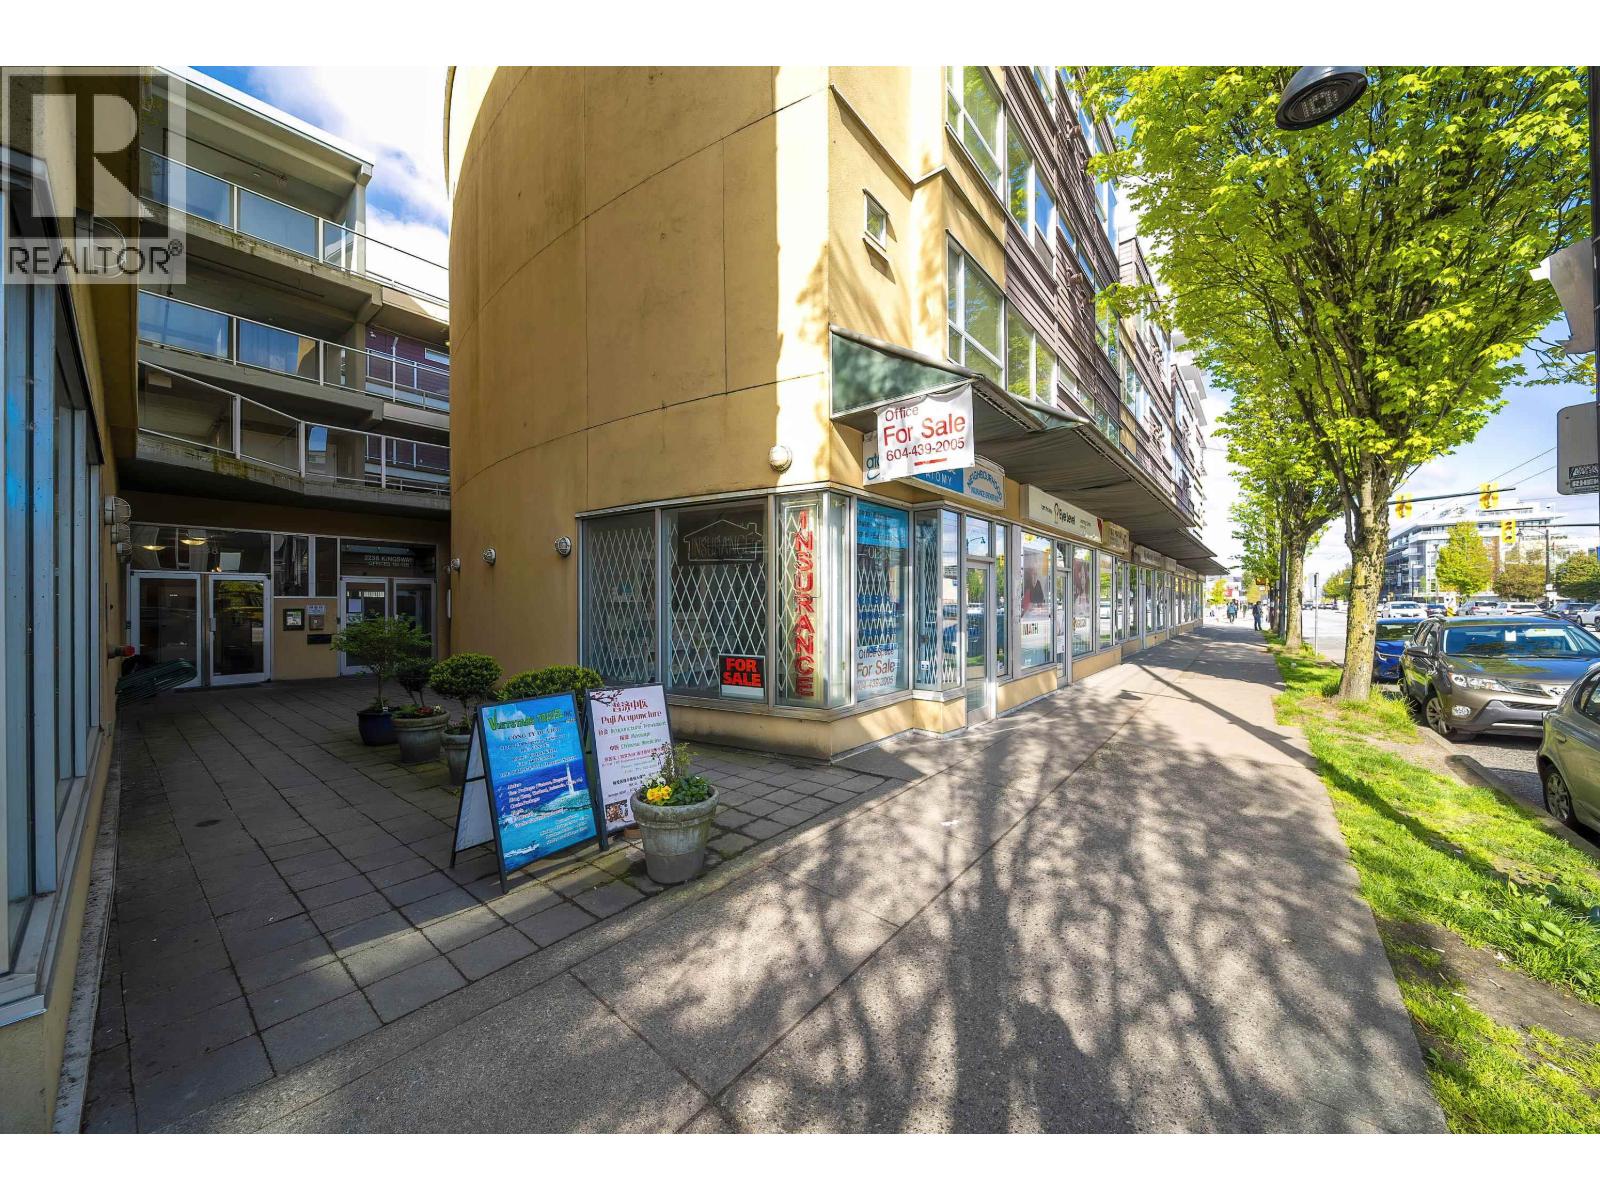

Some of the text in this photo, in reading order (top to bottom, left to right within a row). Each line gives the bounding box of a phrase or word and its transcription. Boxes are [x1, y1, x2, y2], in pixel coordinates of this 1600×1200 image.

[885, 406, 919, 422] Office
[883, 413, 966, 446] For Sale
[886, 437, 965, 461] 604-439-2005
[794, 511, 815, 697] INSURANCE
[725, 657, 757, 672] FOR
[856, 659, 896, 678] For Sale
[723, 671, 761, 687] SALE
[601, 711, 662, 725] Puji Acupuncture
